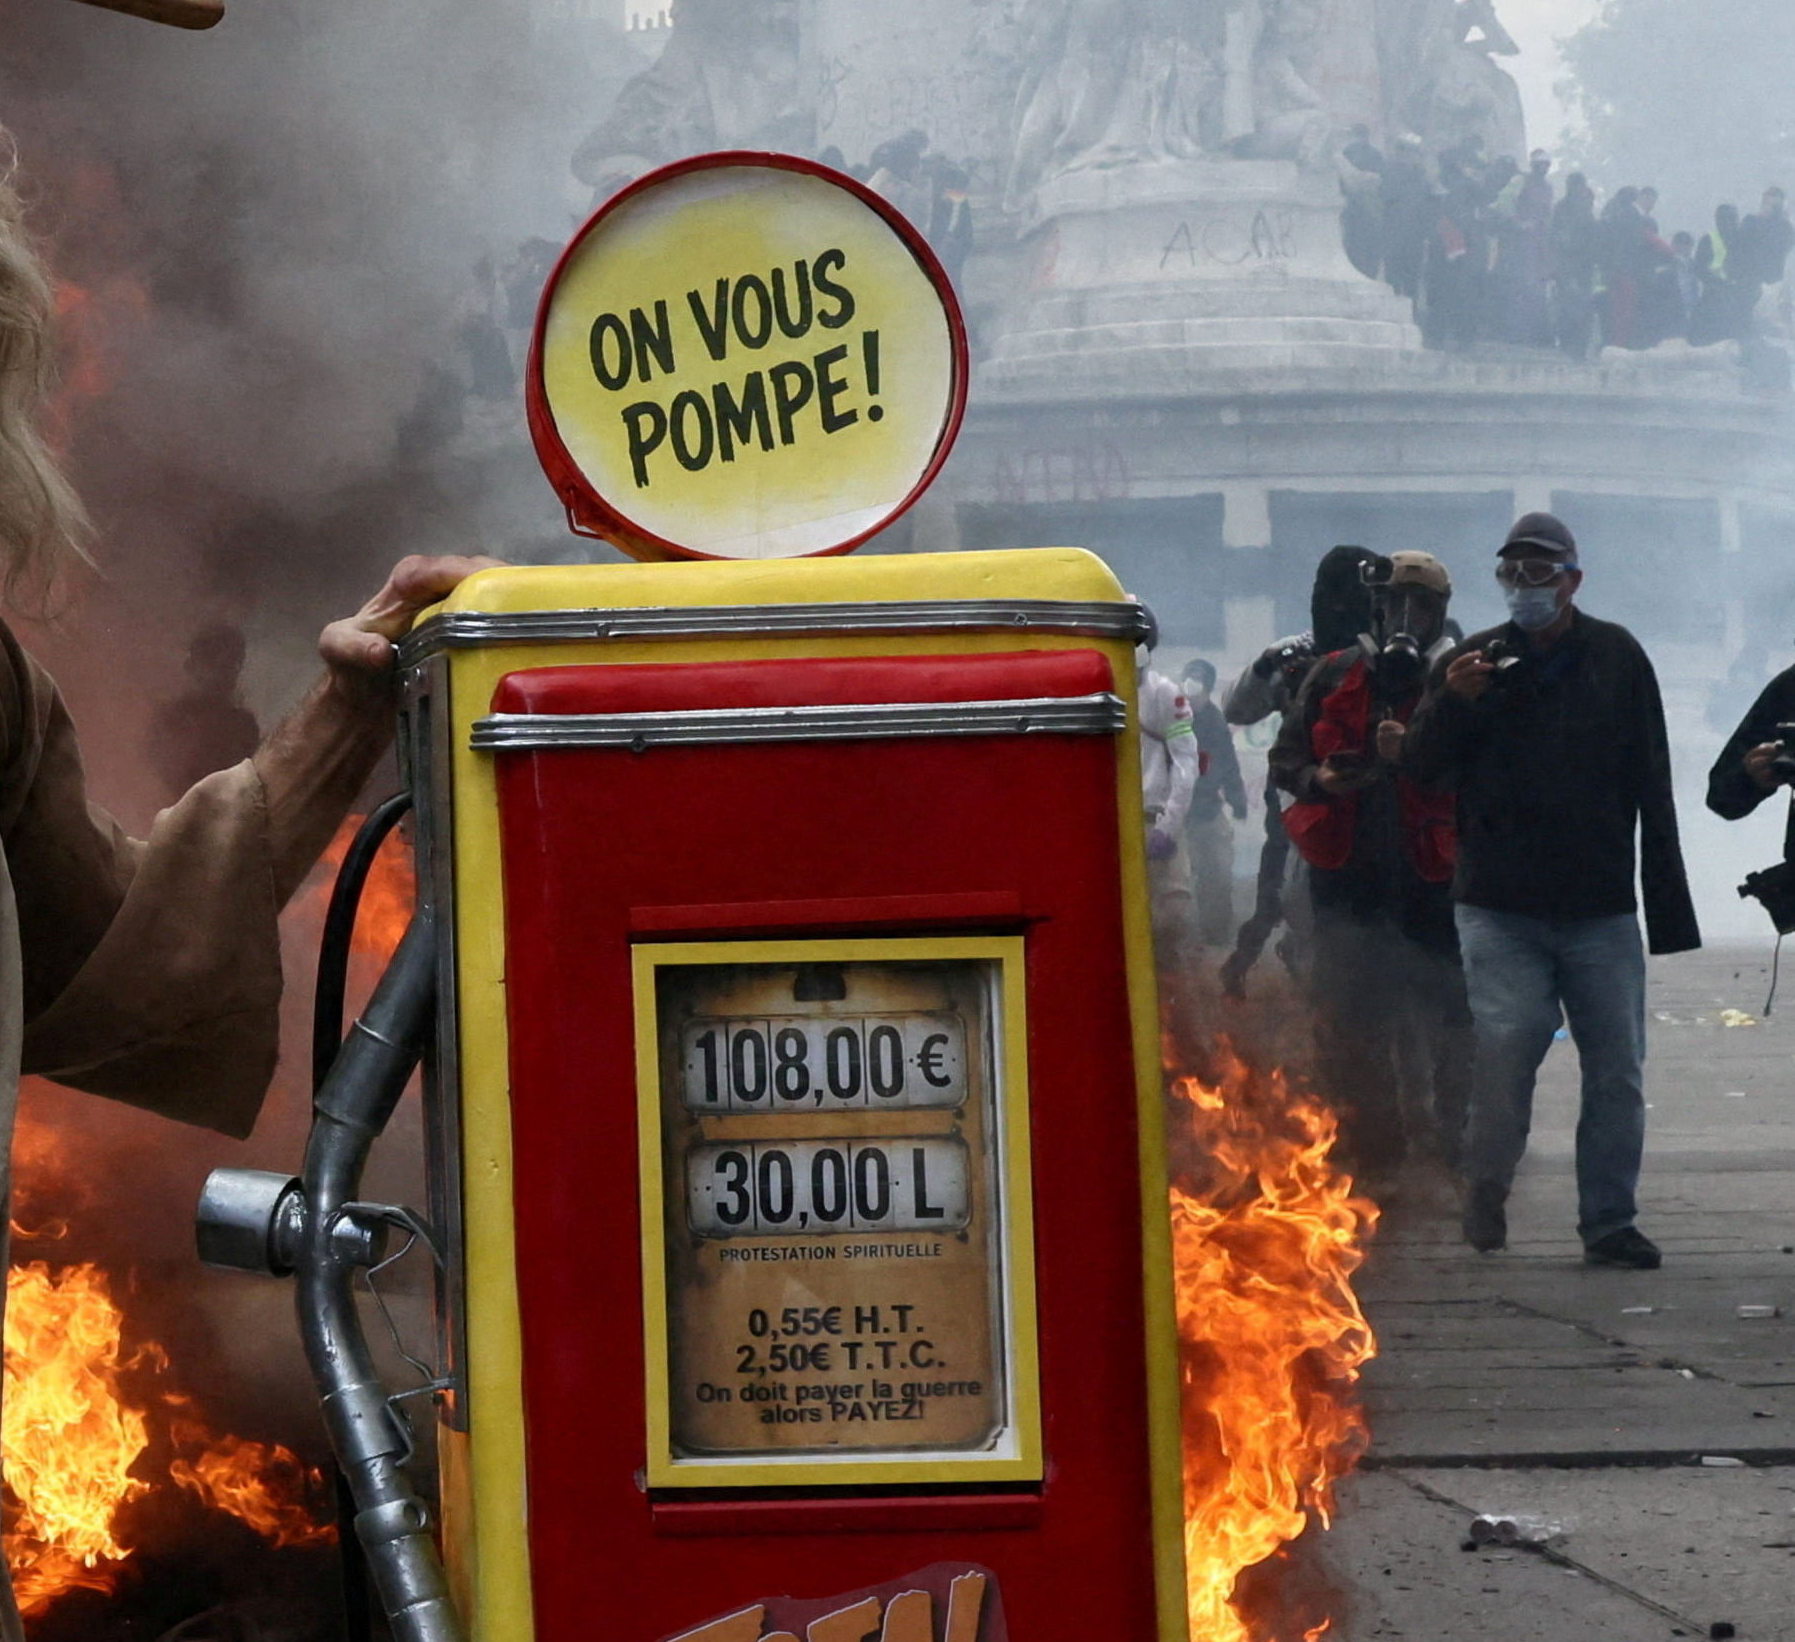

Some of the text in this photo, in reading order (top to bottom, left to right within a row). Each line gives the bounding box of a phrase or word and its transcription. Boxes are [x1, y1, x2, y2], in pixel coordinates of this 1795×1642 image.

[589, 248, 855, 391] ON VOUS
[621, 329, 884, 488] POMPE!
[715, 1147, 944, 1229] 30,00 L
[720, 1243, 942, 1262] PROTESTATION SPIRITUELLE
[748, 1305, 924, 1341] 0,55€ H.T.
[736, 1340, 946, 1378] 2,50€ T.T.C.
[696, 1379, 982, 1405] On doit payer la guerre
[761, 1400, 924, 1424] alors PAYEZ!
